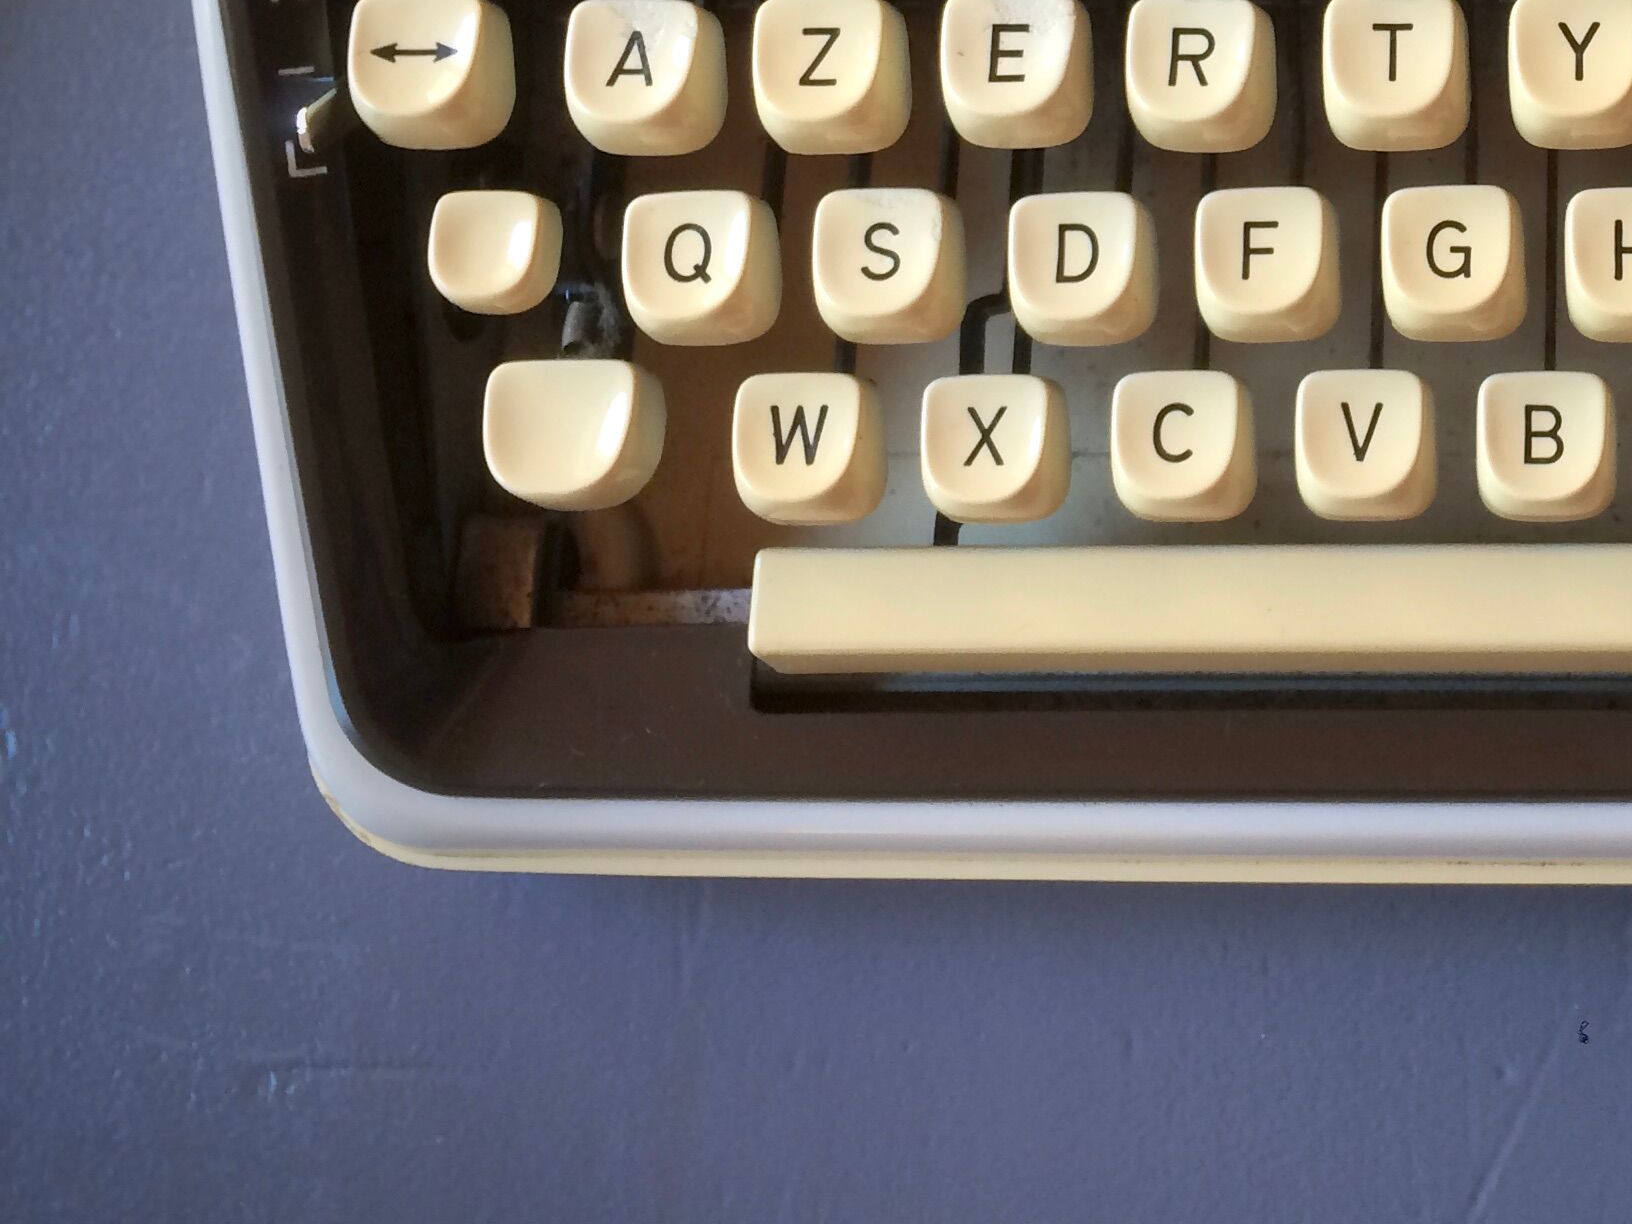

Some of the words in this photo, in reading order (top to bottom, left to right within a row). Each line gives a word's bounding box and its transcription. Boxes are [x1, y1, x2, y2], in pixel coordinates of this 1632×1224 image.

[606, 30, 652, 87] A
[799, 28, 840, 86] Z
[988, 24, 1030, 82] E
[1168, 27, 1215, 86] R
[1372, 23, 1413, 81] T
[1558, 22, 1600, 81] Y
[285, 140, 328, 177] L
[664, 223, 711, 283] Q
[861, 222, 900, 281] S
[1056, 224, 1099, 283] D
[1242, 221, 1279, 280] F
[1426, 220, 1472, 279] G
[770, 405, 829, 466] W
[964, 406, 1007, 466] X
[1153, 403, 1194, 463] C
[1341, 402, 1383, 462] V
[1524, 404, 1564, 464] B
